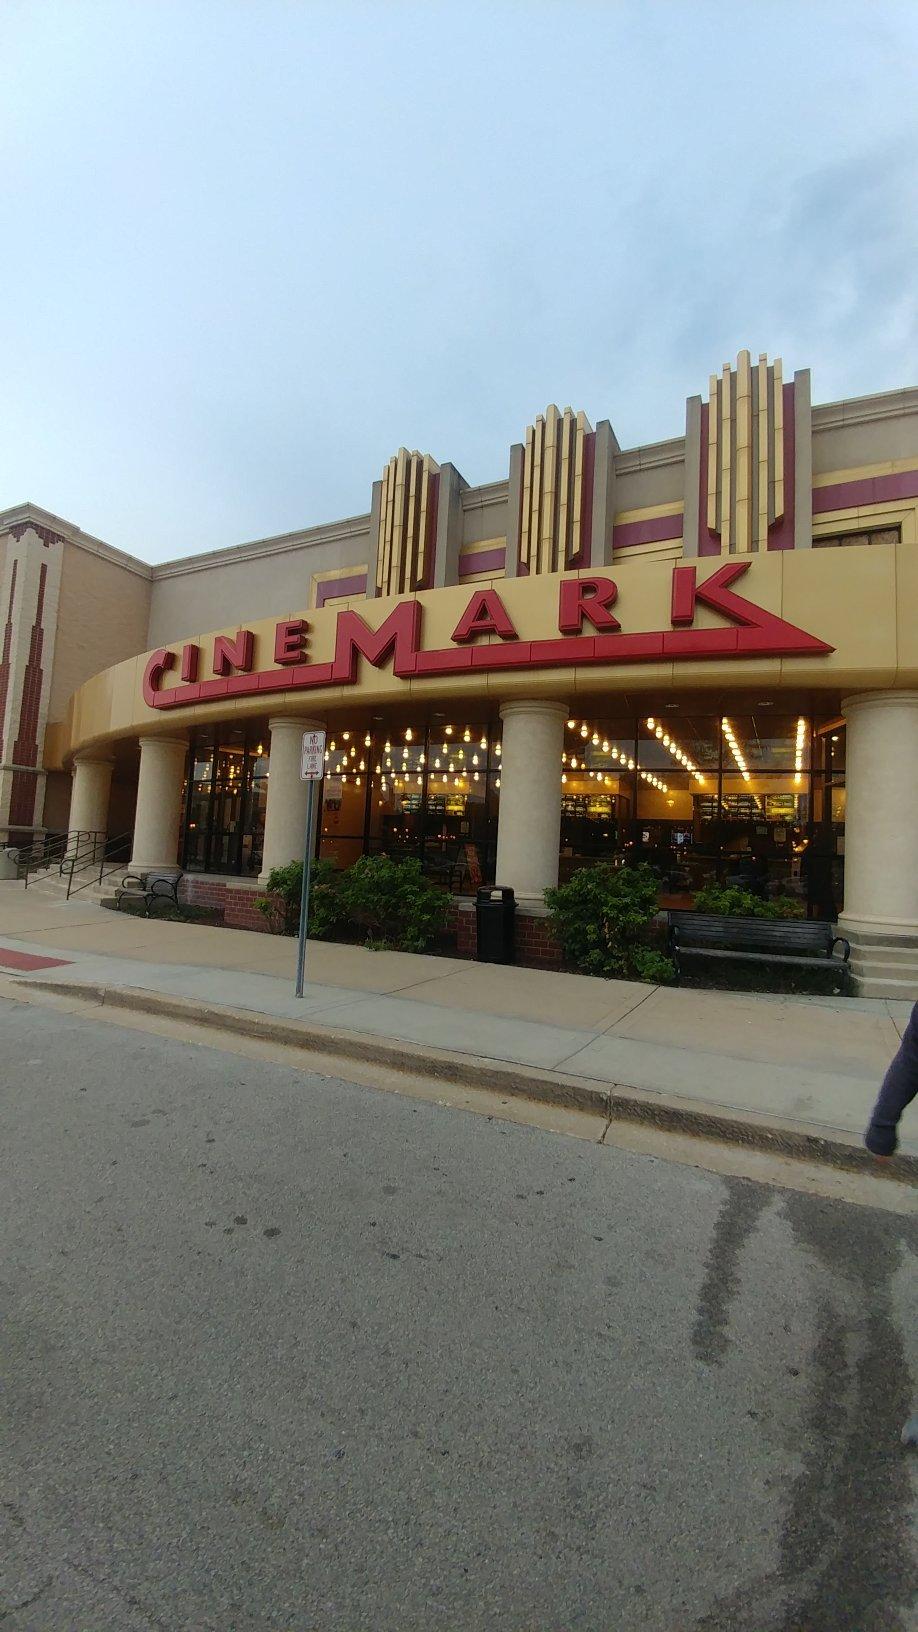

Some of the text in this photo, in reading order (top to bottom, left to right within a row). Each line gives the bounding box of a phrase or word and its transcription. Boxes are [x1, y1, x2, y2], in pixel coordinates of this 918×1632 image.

[142, 561, 837, 709] CINEMARK
[310, 736, 318, 745] NO
[304, 745, 322, 754] PARKING
